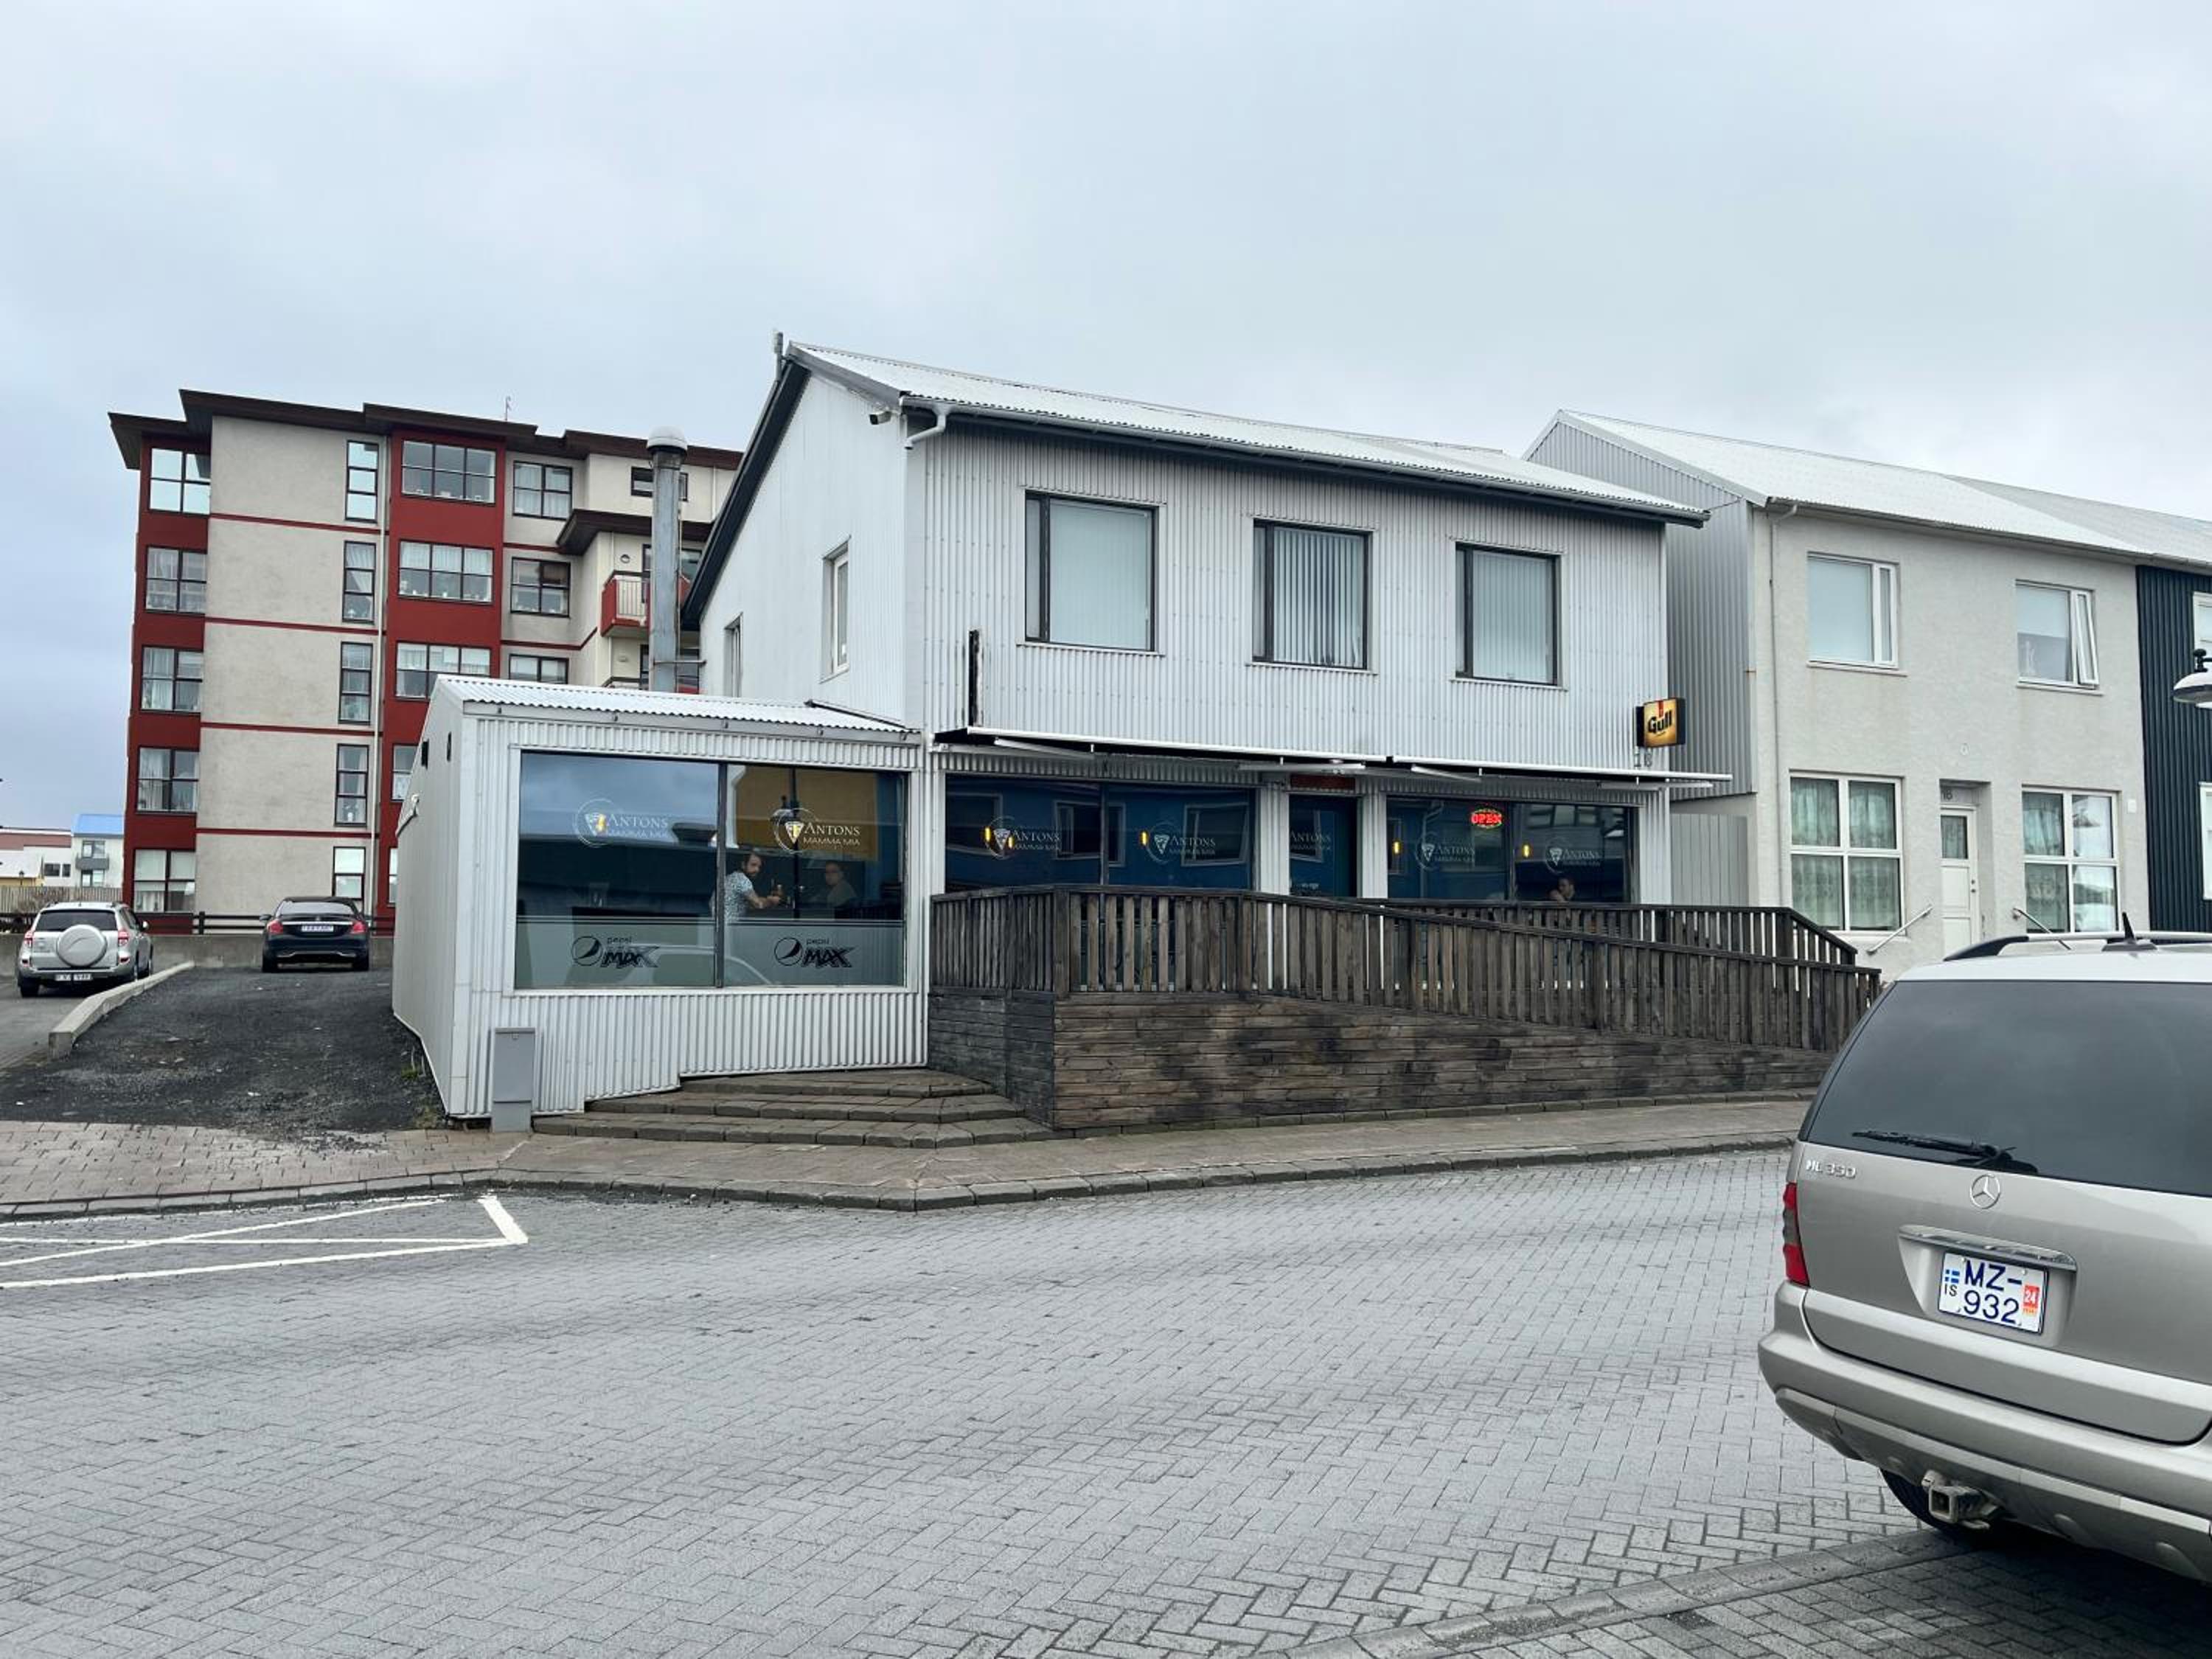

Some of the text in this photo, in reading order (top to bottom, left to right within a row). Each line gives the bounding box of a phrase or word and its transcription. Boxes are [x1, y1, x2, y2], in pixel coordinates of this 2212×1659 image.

[1648, 709, 1672, 734] Gull
[607, 813, 669, 828] ANTONS
[804, 822, 861, 836] ANTONS
[1012, 830, 1062, 842] ANTONS
[802, 836, 841, 845] MAMMA
[1169, 835, 1216, 848] ANTONS
[607, 936, 633, 945] pepsi
[599, 946, 661, 969] MAX
[800, 946, 855, 969] MAX
[1826, 1163, 1857, 1180] 350
[1944, 1283, 1958, 1297] IS
[2024, 1289, 2037, 1304] 24
[1963, 1290, 2020, 1324] 932
